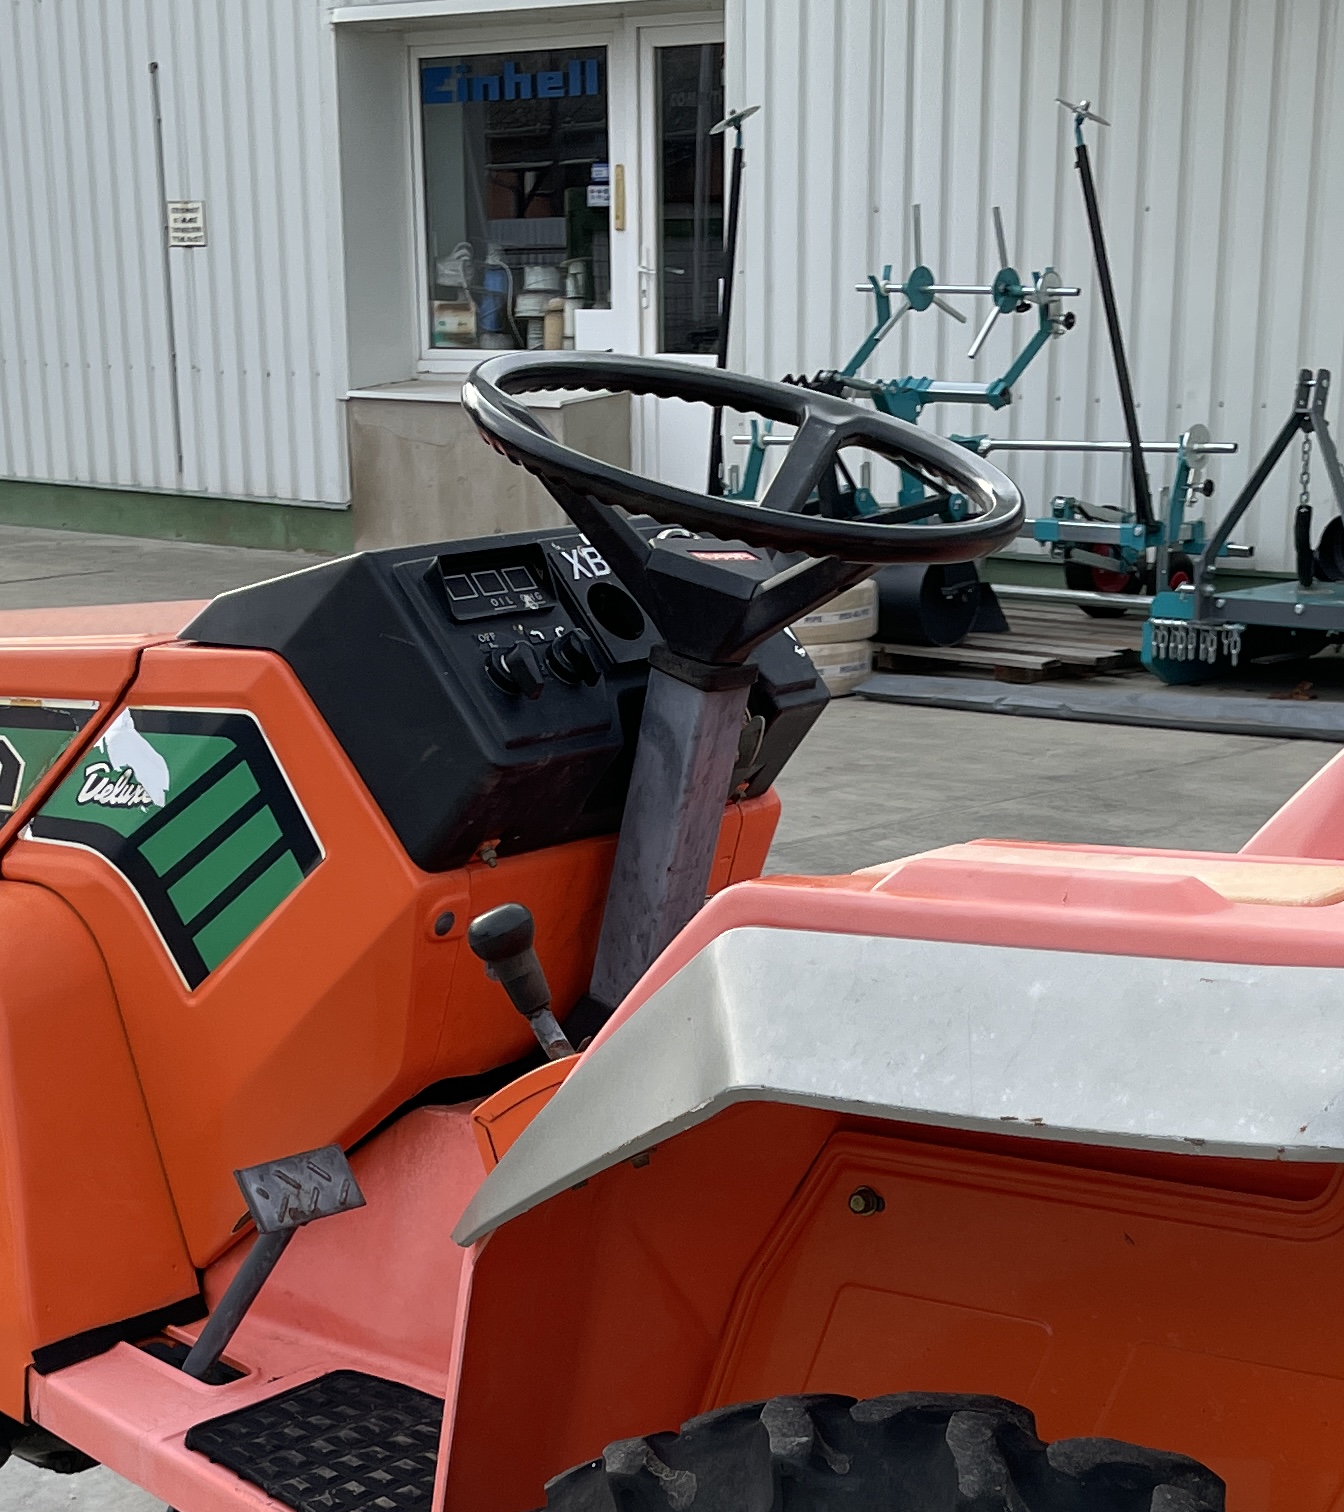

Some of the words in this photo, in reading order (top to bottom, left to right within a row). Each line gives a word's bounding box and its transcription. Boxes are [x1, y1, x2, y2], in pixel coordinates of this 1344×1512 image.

[422, 59, 599, 104] Einhell
[490, 596, 514, 607] OIL
[477, 632, 496, 643] OFF
